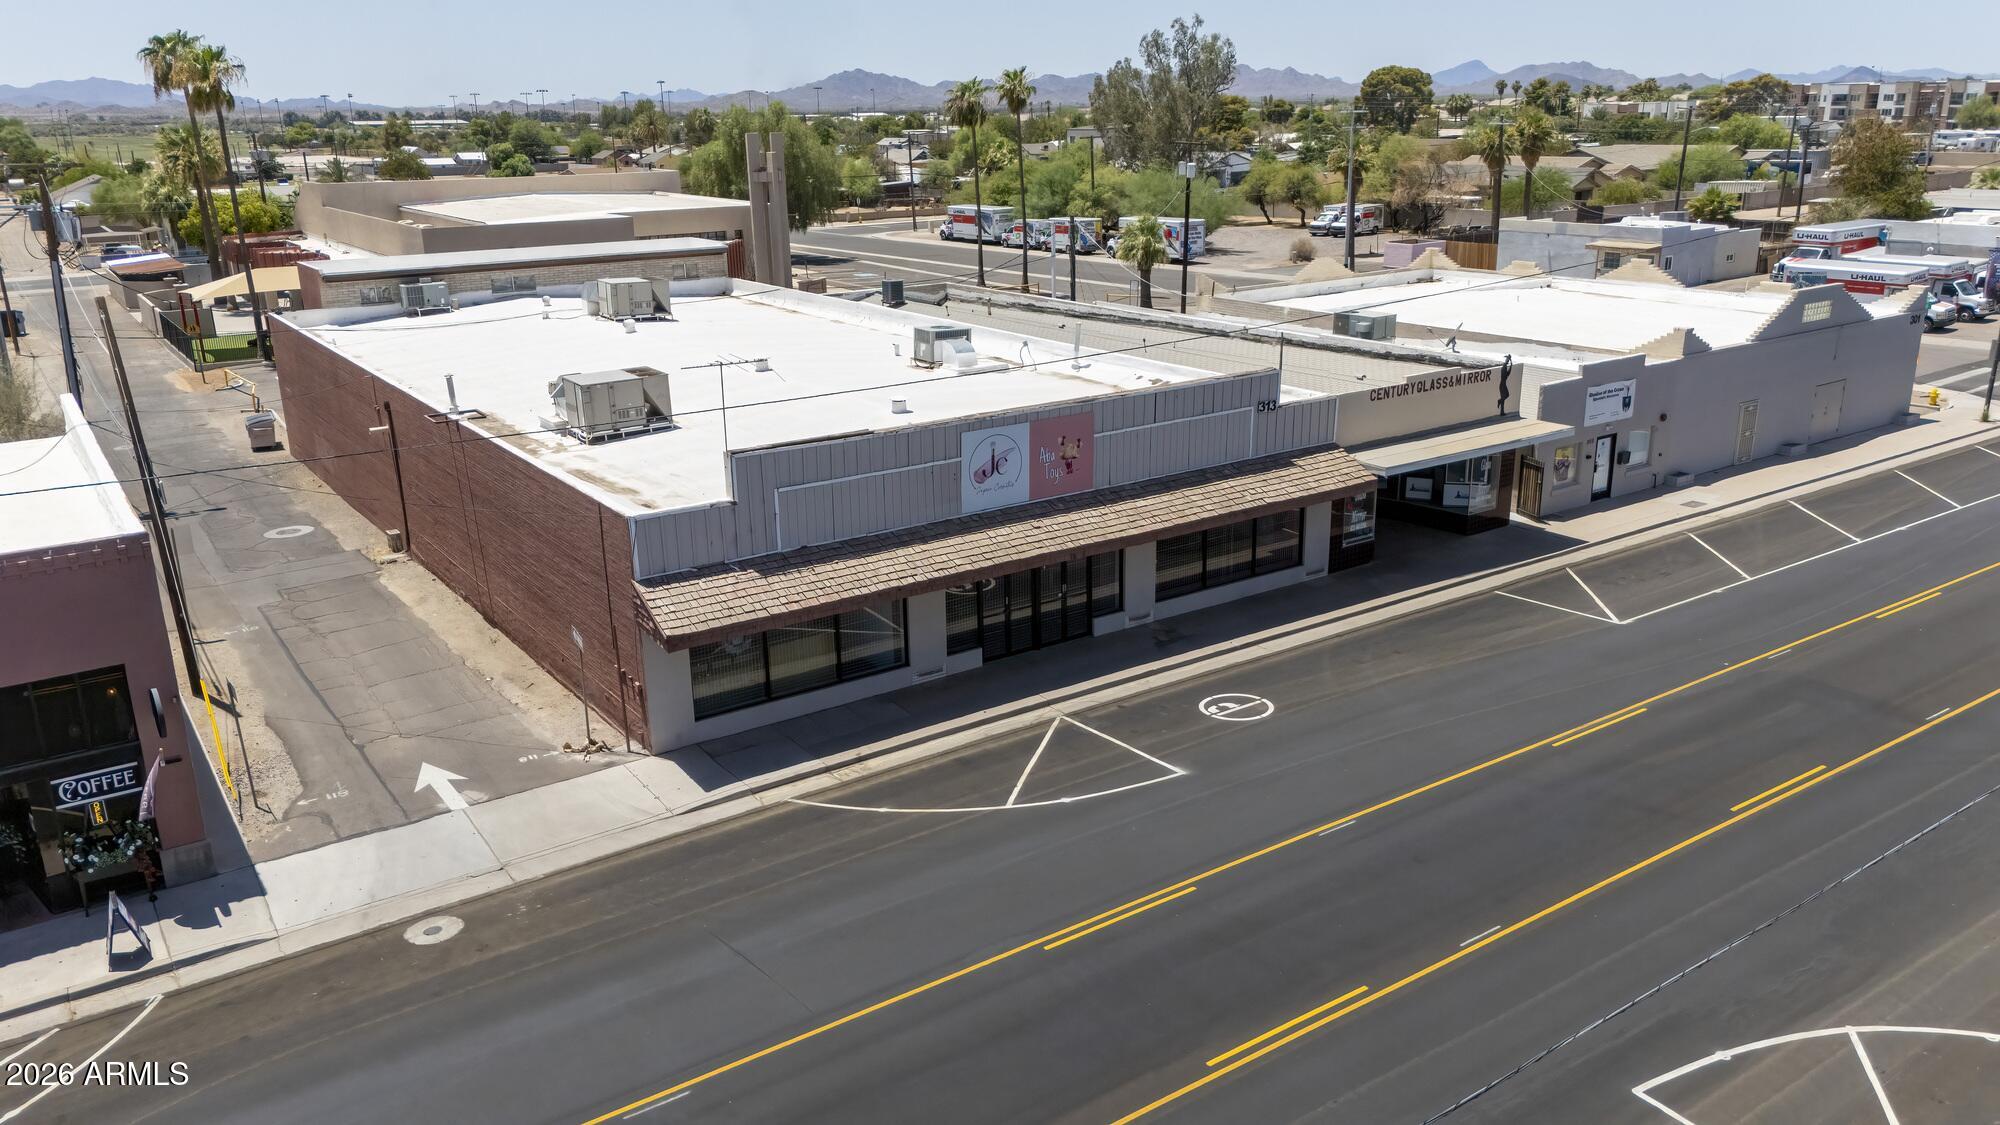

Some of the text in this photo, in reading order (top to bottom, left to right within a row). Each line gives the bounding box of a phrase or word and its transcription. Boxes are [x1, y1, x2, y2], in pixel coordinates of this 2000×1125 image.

[1844, 231, 1864, 239] U-HAUL
[1850, 273, 1886, 282] U-HAUL
[1370, 382, 1416, 401] CENTURY
[1455, 370, 1492, 386] MIRROR
[1045, 463, 1064, 484] Toys
[58, 769, 136, 803] COFFEE
